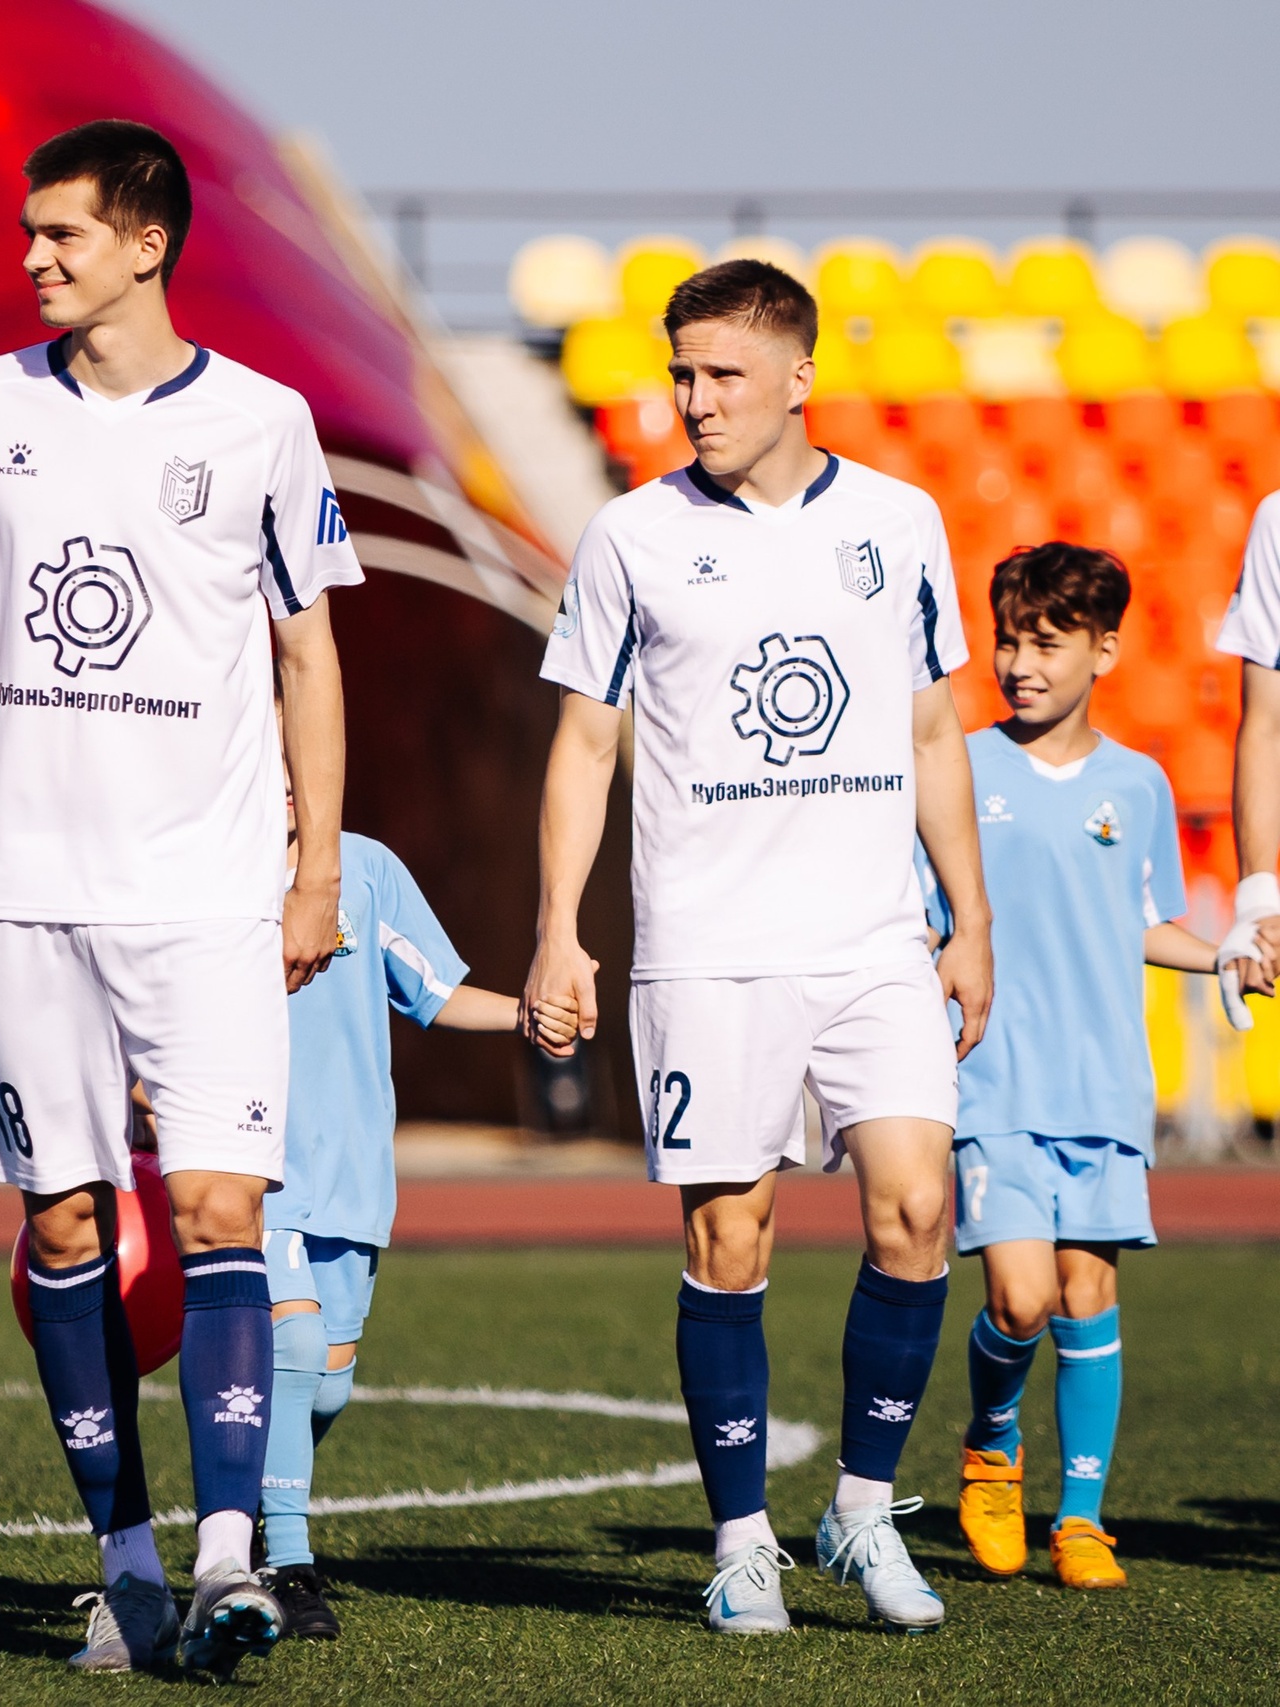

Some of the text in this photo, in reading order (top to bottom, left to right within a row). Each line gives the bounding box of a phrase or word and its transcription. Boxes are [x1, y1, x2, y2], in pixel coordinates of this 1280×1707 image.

[176, 486, 195, 497] 1932
[687, 574, 728, 586] KELME
[692, 774, 904, 805] КубаньЭнергоРемонт
[651, 1069, 691, 1150] 32
[237, 1123, 273, 1135] KELME
[964, 1165, 988, 1222] 7
[214, 1411, 263, 1428] KELME
[867, 1410, 912, 1423] KELME
[66, 1430, 115, 1450] KELME
[715, 1432, 757, 1448] KELME
